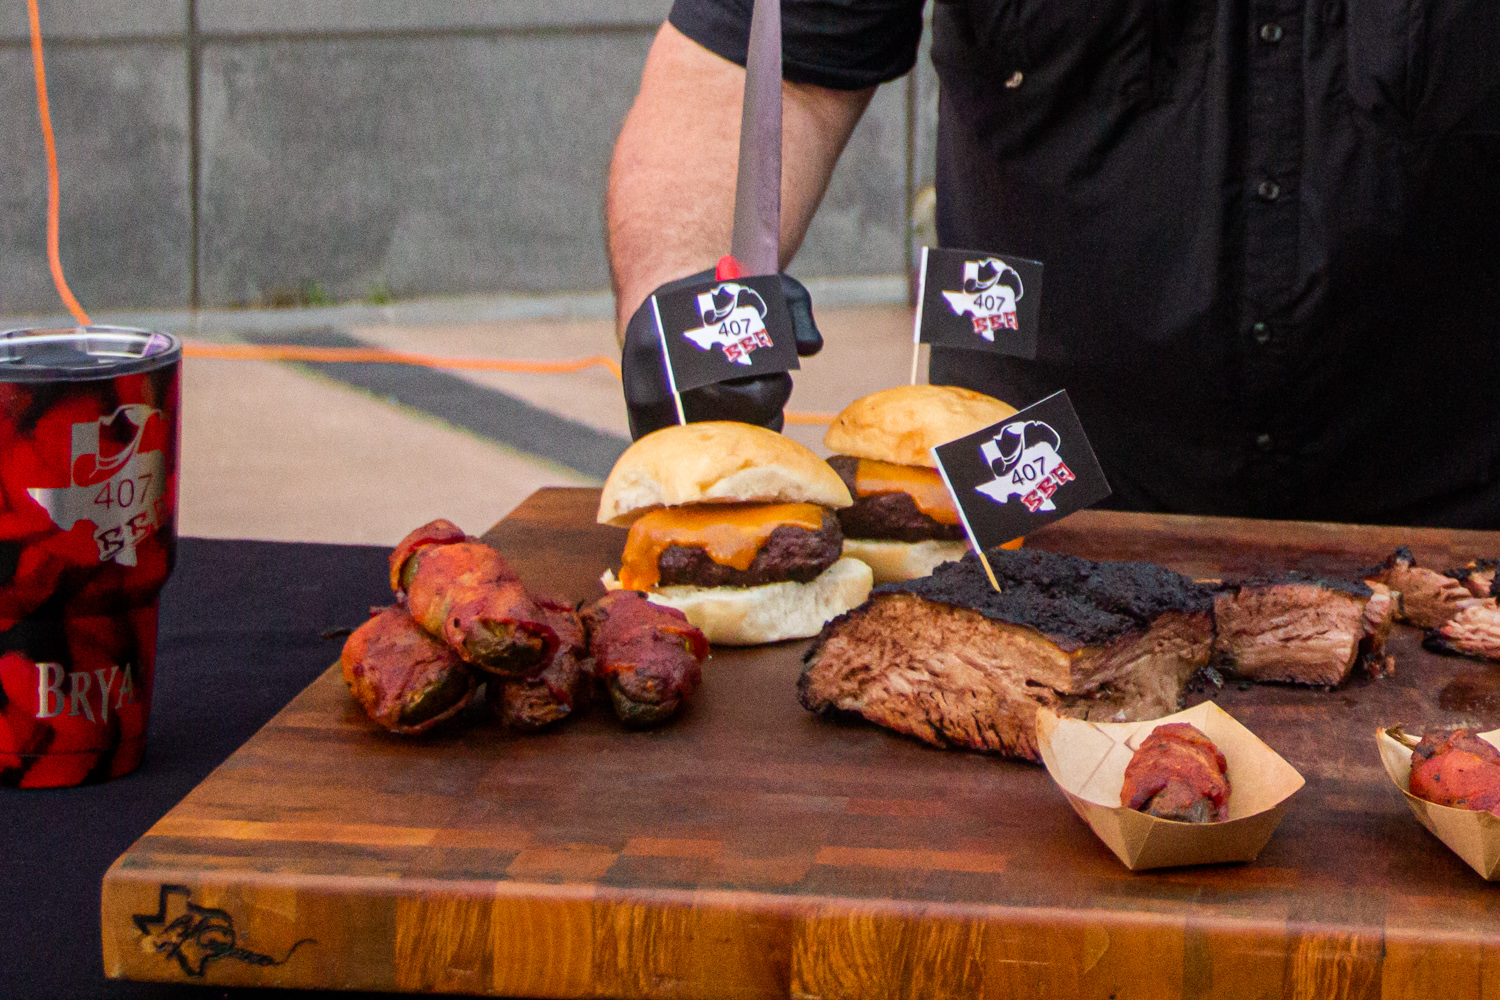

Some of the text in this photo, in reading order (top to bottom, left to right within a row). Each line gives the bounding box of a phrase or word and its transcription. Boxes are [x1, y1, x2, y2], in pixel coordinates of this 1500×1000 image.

[973, 294, 1006, 312] 407
[718, 318, 751, 337] 407
[1012, 456, 1046, 486] 407
[93, 472, 153, 510] 407
